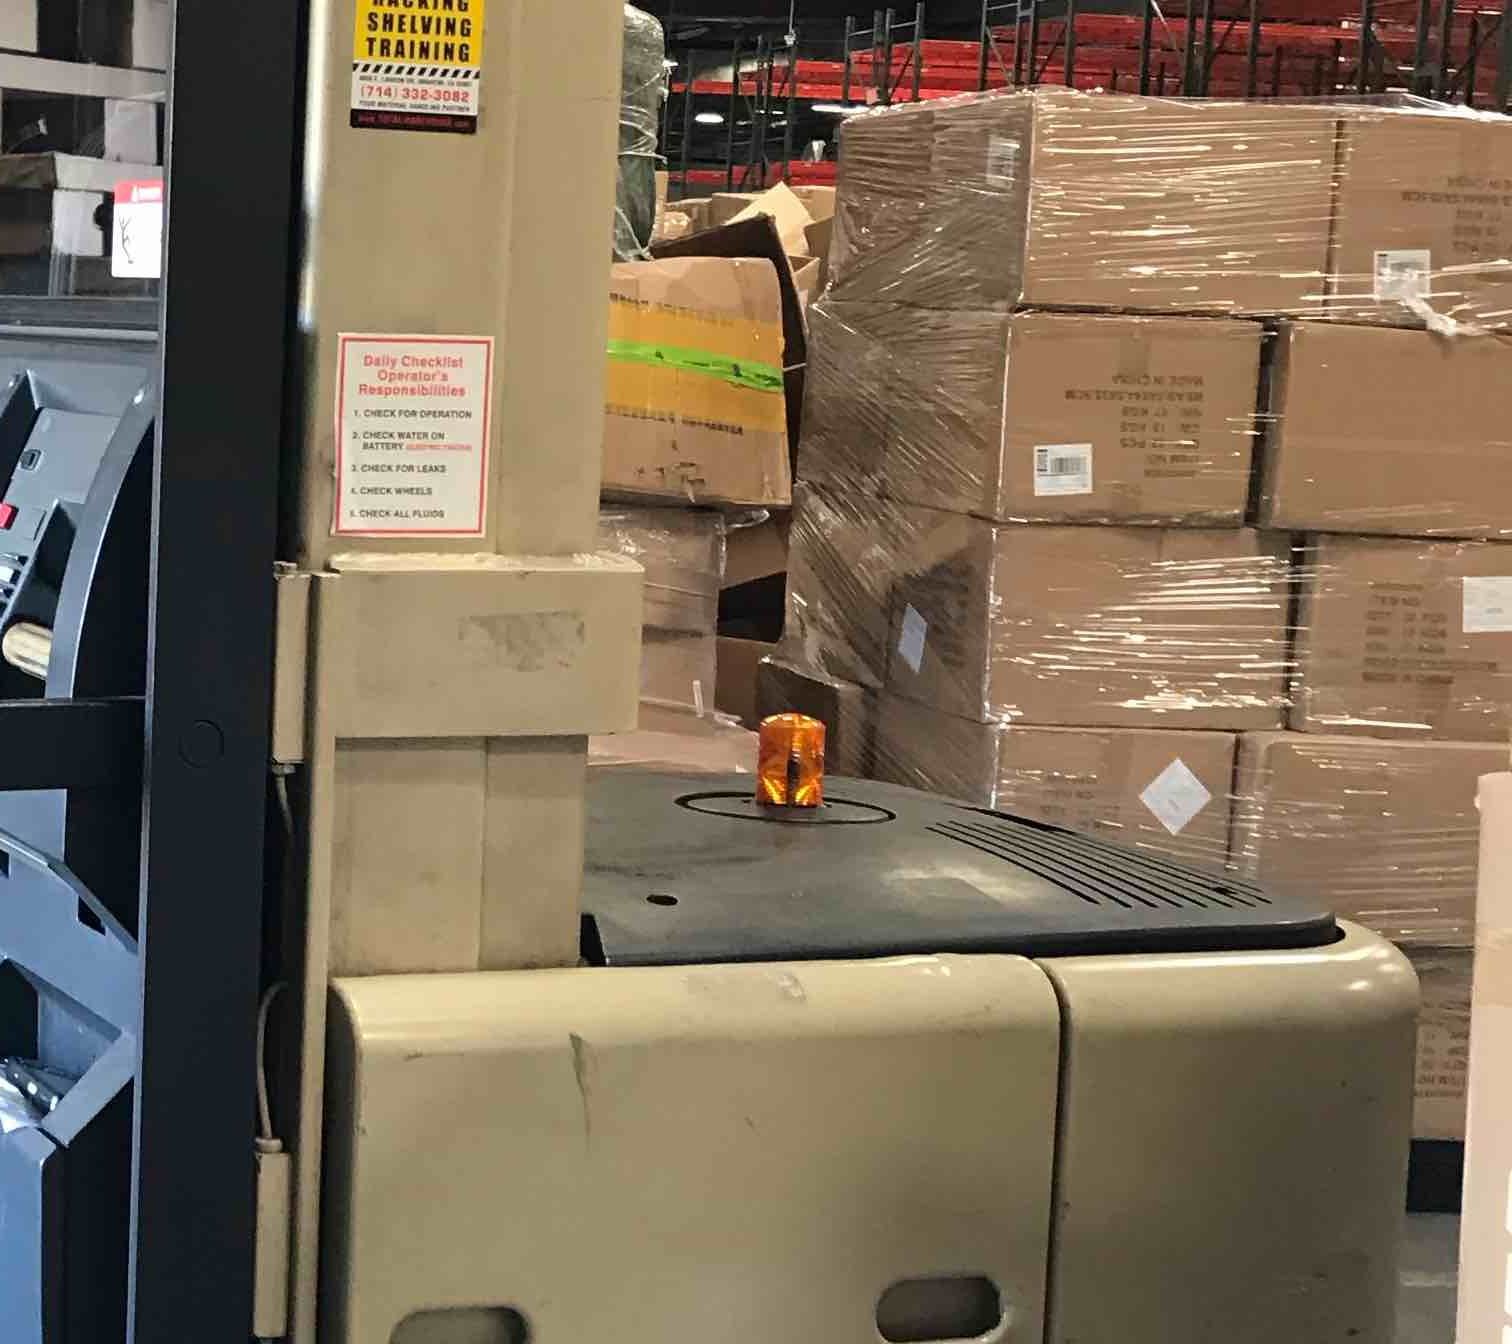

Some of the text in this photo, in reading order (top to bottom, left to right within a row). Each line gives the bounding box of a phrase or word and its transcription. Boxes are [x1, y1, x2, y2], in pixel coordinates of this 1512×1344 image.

[367, 11, 472, 38] SHELVING
[365, 36, 470, 63] TRAINING
[402, 86, 470, 103] 332-3082
[363, 354, 464, 369] Daily Checklist
[377, 368, 449, 383] Operator's
[358, 383, 466, 398] Responsibilities
[363, 408, 396, 418] CHECK
[398, 409, 418, 418] FOR
[419, 409, 473, 419] OPERATION
[362, 431, 395, 440] CHECK
[397, 431, 429, 440] WATER
[430, 431, 445, 441] ON
[362, 441, 404, 450] BATTERY
[360, 463, 394, 473] CHECK
[395, 464, 415, 473] FOR
[416, 464, 447, 473] LEAKS
[359, 487, 392, 496] CHECK
[394, 487, 433, 496] WHEELS
[359, 509, 391, 518] CHECK
